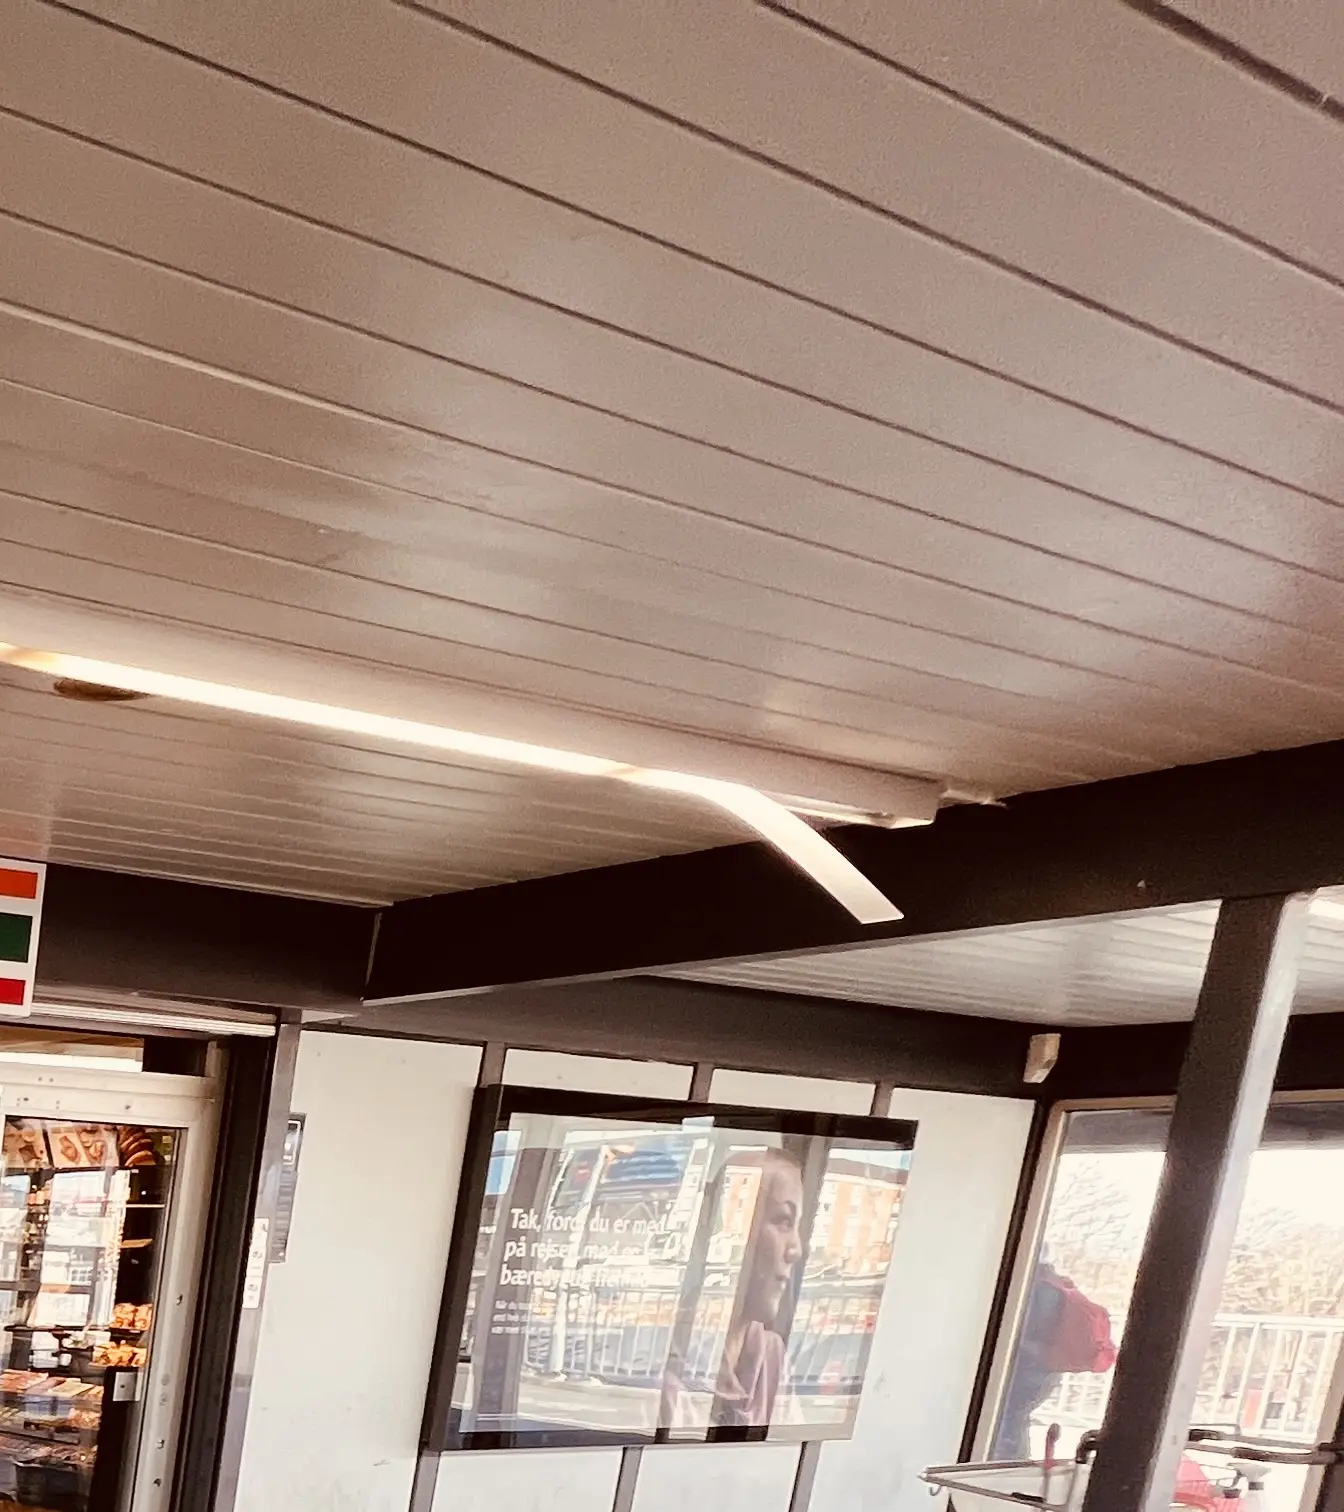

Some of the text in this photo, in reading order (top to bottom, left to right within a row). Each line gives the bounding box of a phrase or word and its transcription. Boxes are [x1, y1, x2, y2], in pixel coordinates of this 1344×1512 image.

[510, 1205, 667, 1235] Tak, ford du er med
[503, 1235, 526, 1262] på
[530, 1239, 579, 1263] rejse
